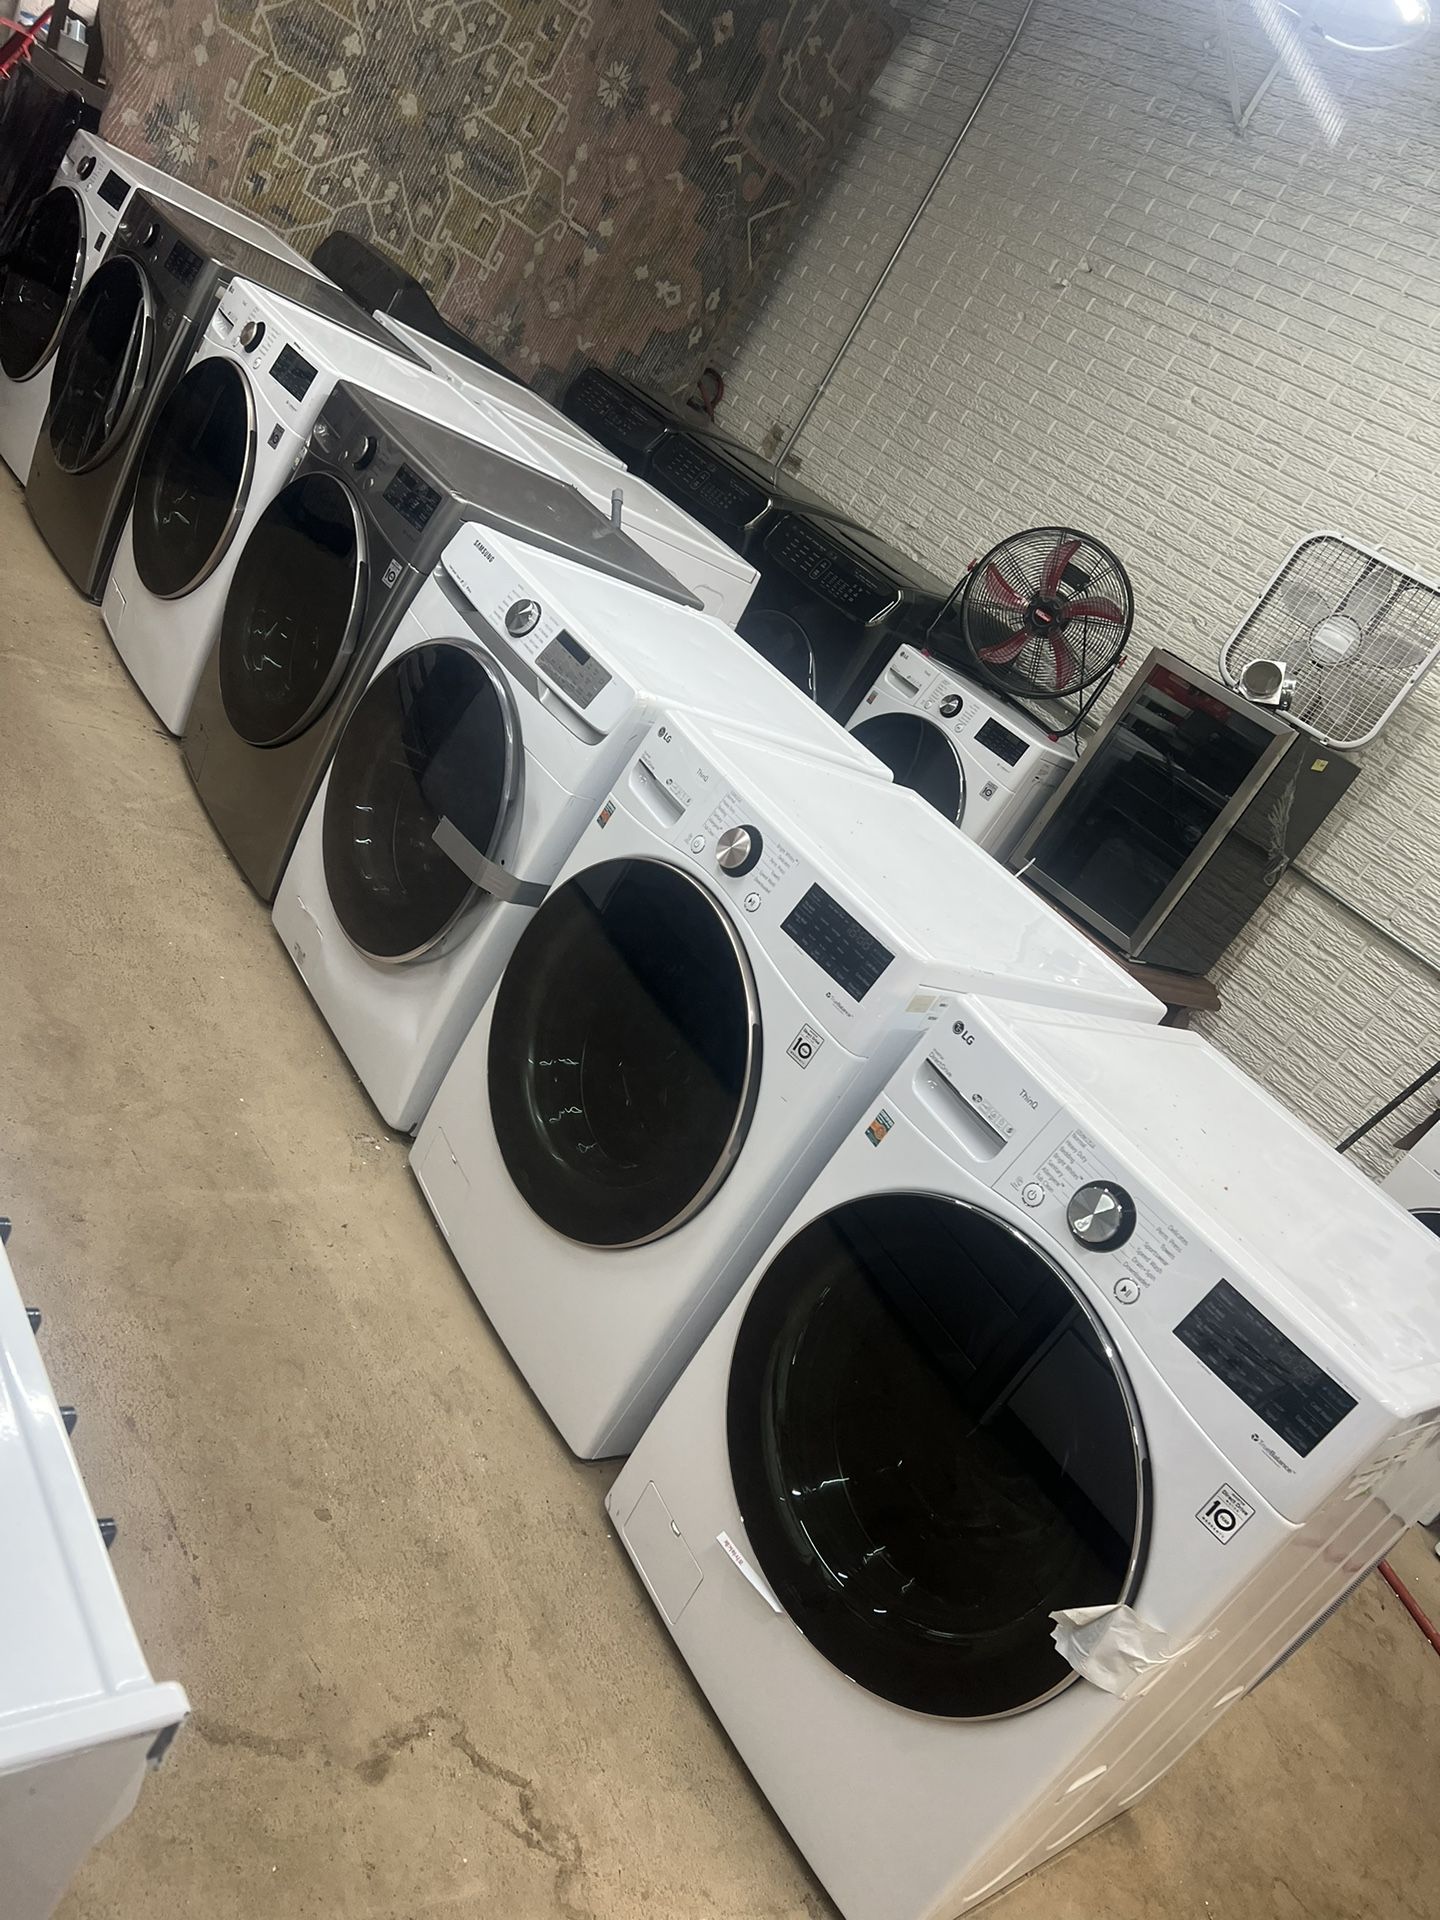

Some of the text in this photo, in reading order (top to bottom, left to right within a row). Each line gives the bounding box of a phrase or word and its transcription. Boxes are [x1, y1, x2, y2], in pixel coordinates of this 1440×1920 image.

[472, 539, 495, 563] SAMSUNG
[662, 732, 672, 744] LG
[982, 785, 993, 797] 10
[791, 1037, 814, 1060] 10
[960, 1030, 976, 1046] LG
[1017, 1088, 1040, 1110] ThinQ
[1221, 1489, 1248, 1515] Direct Drive
[1203, 1498, 1240, 1535] 10
